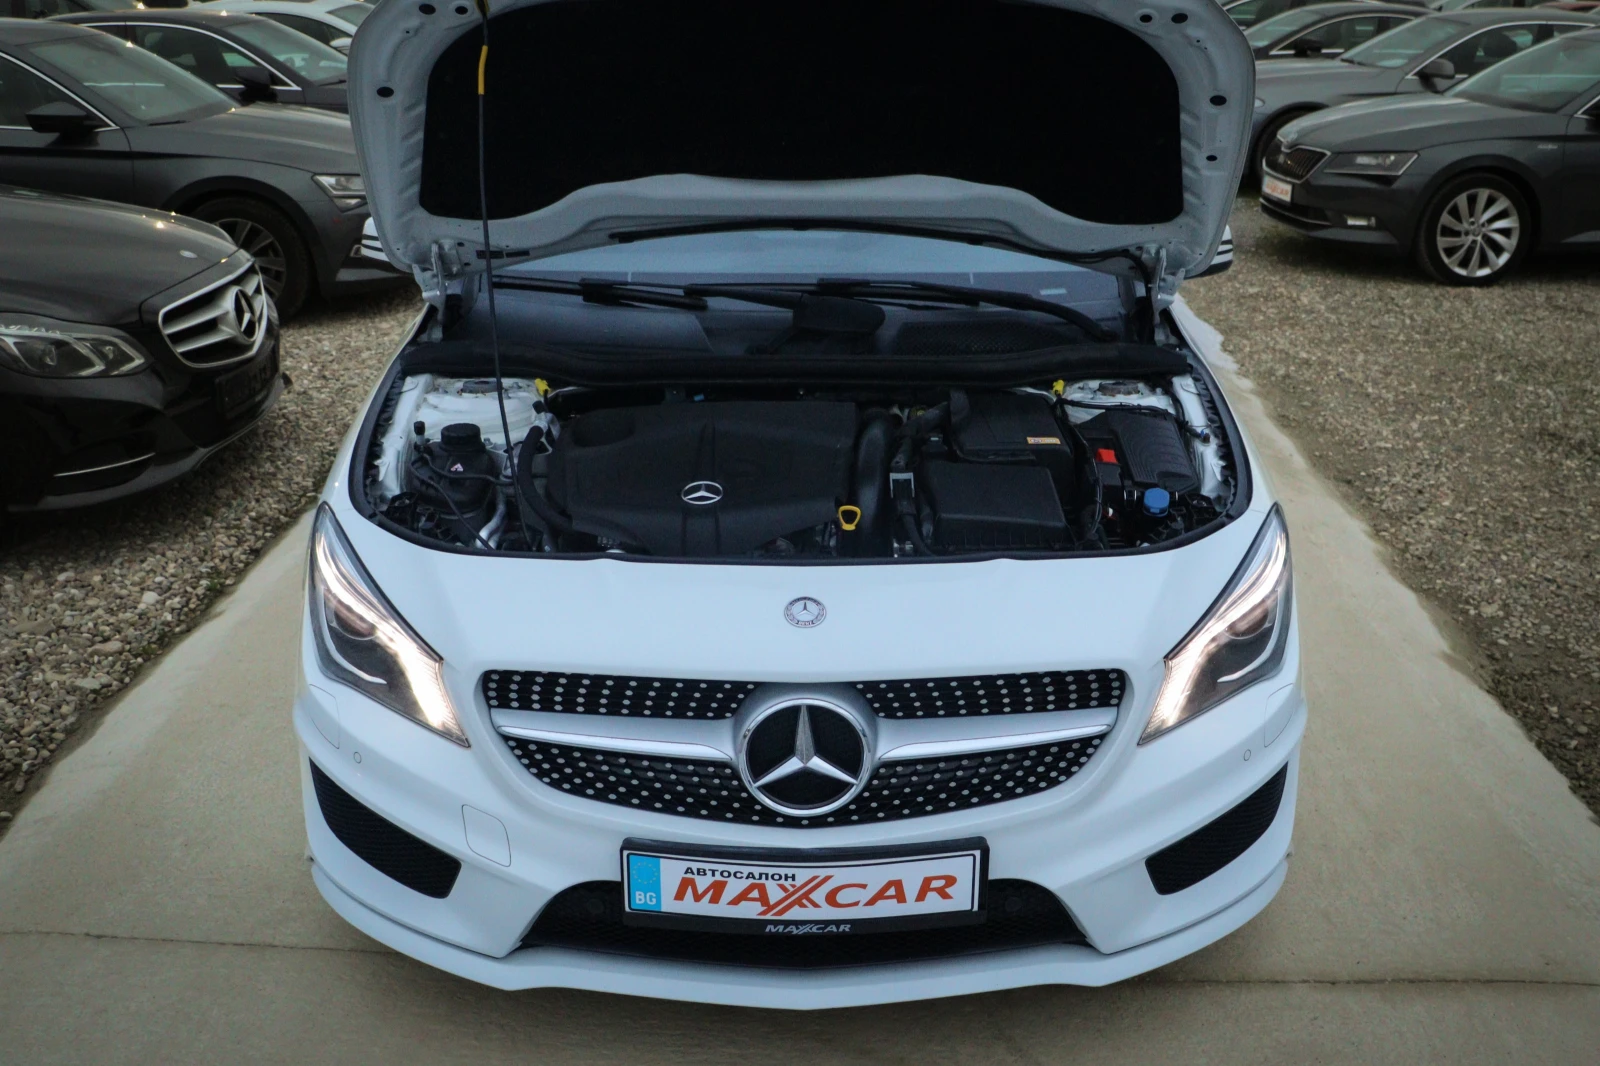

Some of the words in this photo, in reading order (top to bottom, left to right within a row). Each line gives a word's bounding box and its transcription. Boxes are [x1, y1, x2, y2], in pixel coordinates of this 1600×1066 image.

[684, 867, 796, 882] АВТОСАЛОН
[635, 891, 657, 905] BG
[673, 875, 958, 916] MAXCAR
[765, 923, 851, 935] MAXCAR
